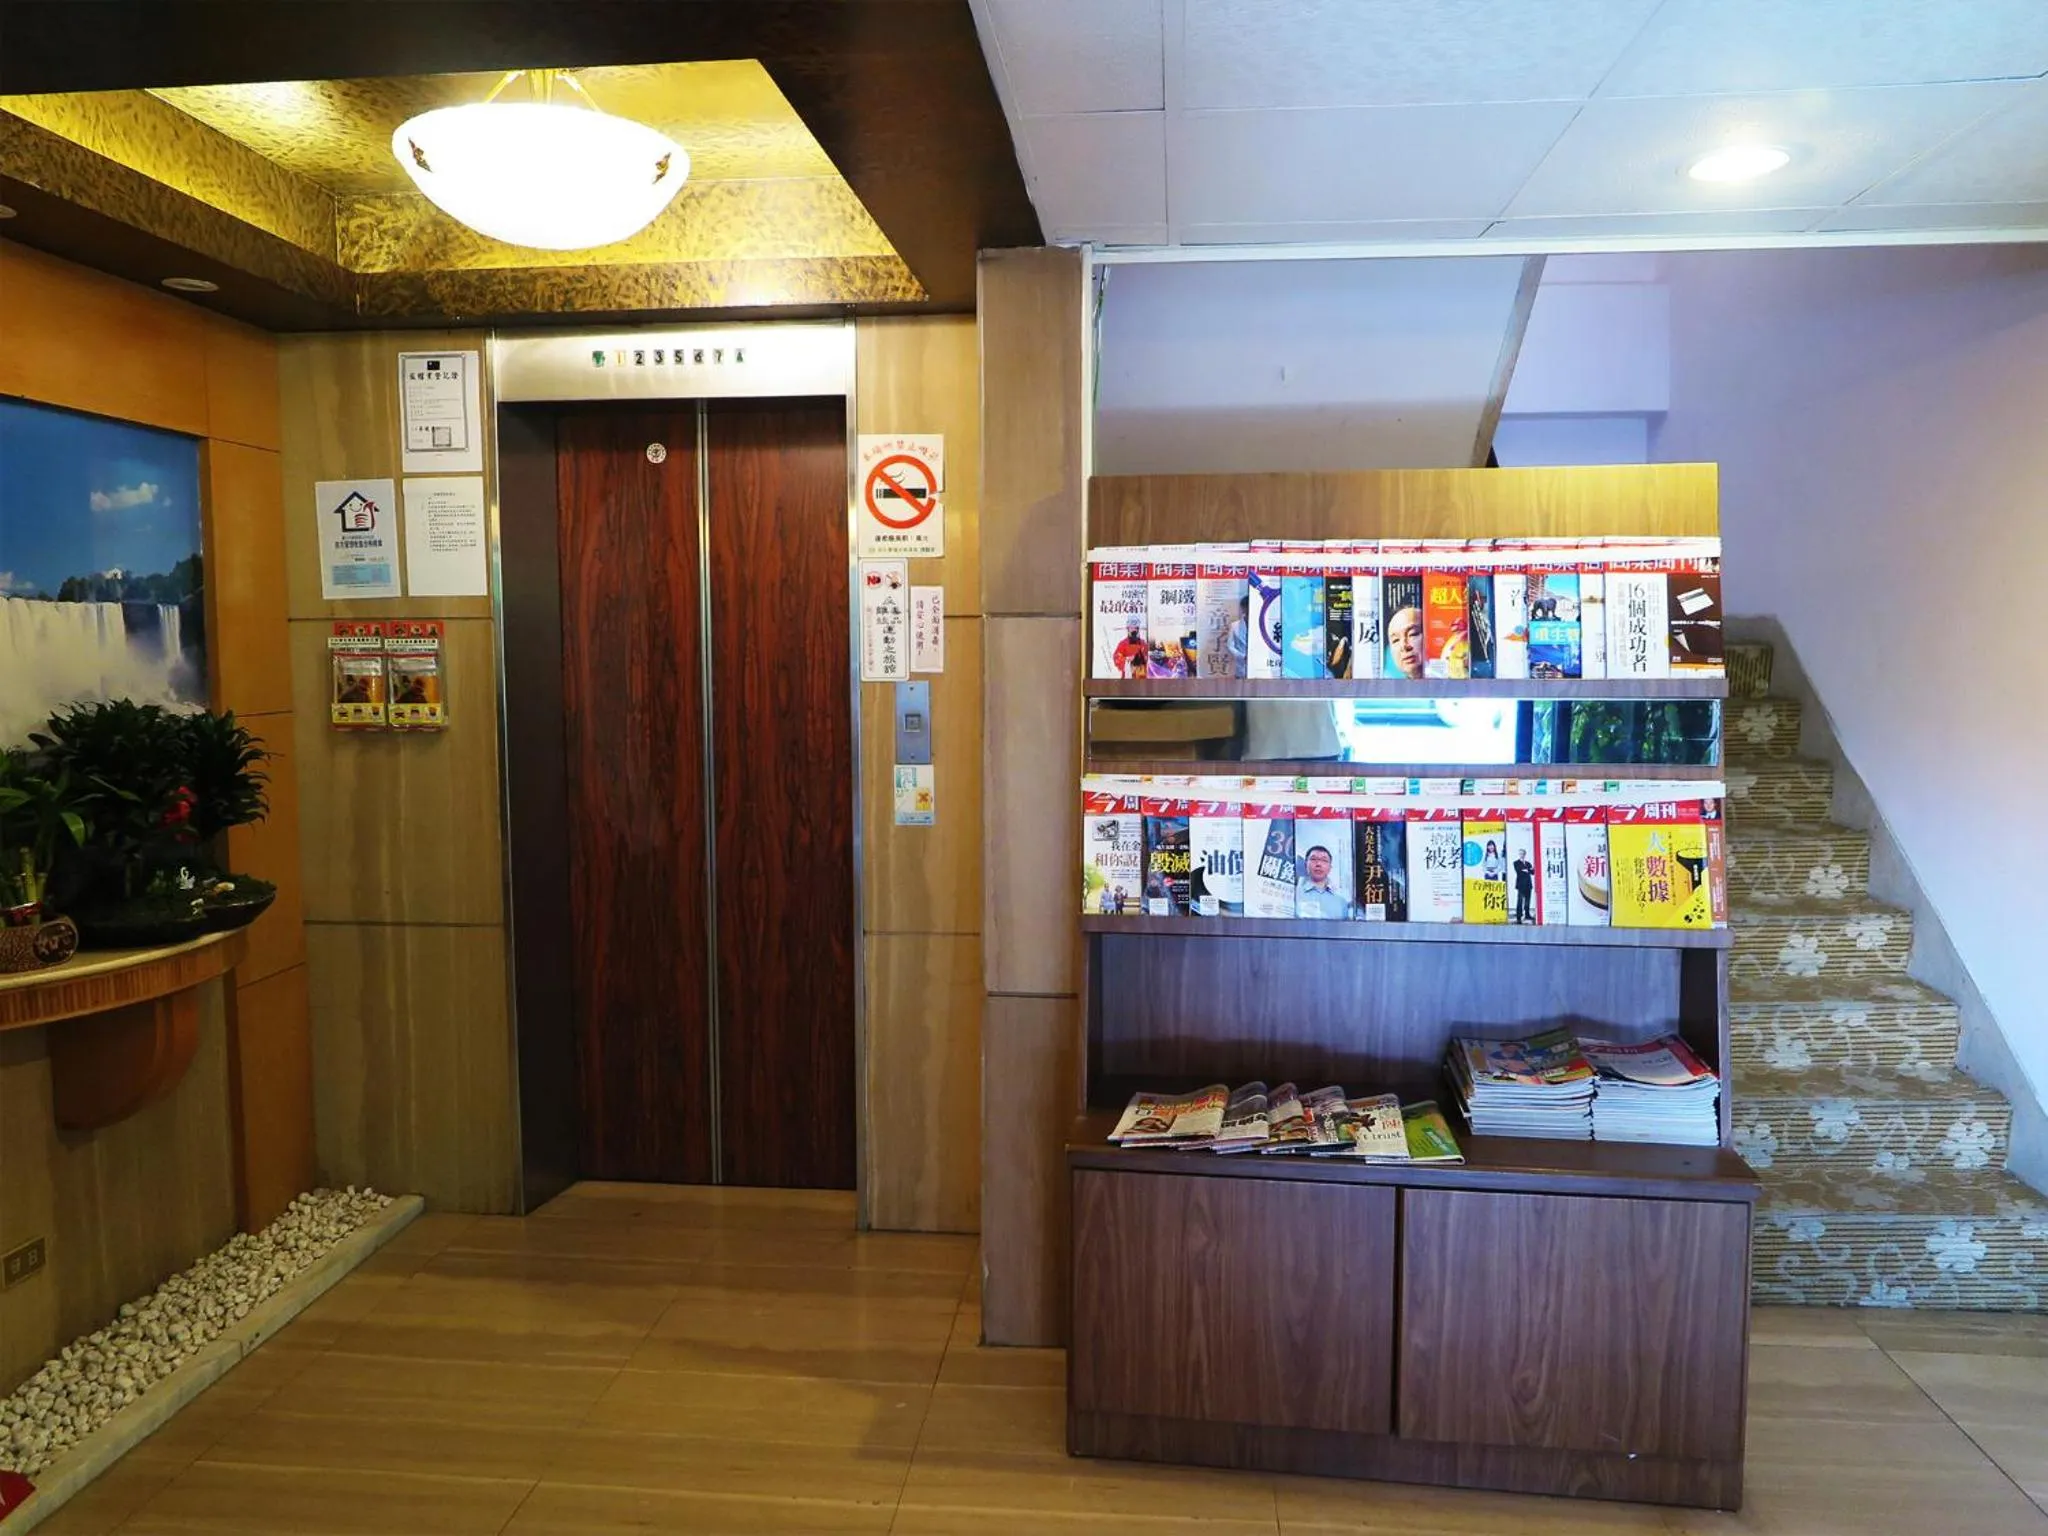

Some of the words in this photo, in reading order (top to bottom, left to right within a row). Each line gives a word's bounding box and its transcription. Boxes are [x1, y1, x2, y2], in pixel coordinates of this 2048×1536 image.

[635, 351, 643, 365] 2
[655, 350, 663, 363] 3
[674, 350, 682, 363] 5
[694, 351, 702, 363] 6
[1430, 587, 1468, 604] 超人
[1099, 600, 1148, 614] 最敢給
[1583, 855, 1606, 878] 新
